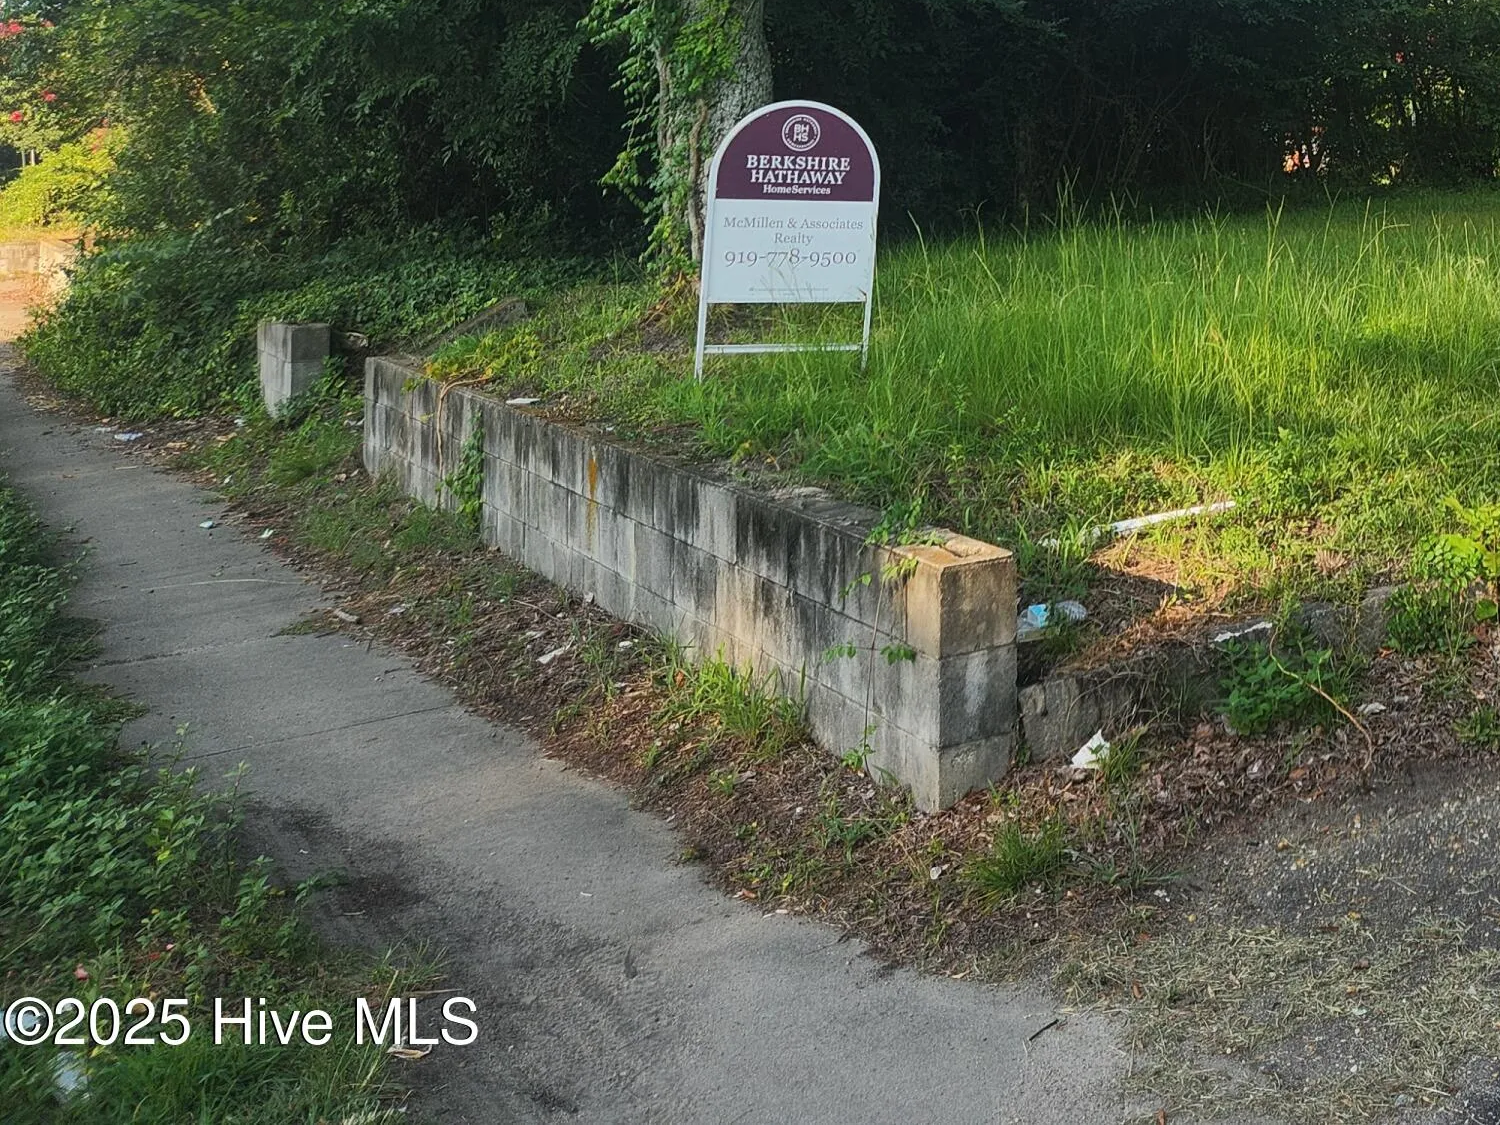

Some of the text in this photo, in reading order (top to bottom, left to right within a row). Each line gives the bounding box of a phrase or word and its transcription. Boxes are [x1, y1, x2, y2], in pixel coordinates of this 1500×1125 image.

[746, 154, 850, 171] BERKSHIRE
[750, 169, 846, 185] HATHAWAY
[762, 184, 831, 195] HomeServices
[723, 216, 864, 230] McMillen & Associates
[774, 232, 814, 246] Realty
[725, 248, 857, 268] 919-778-9500
